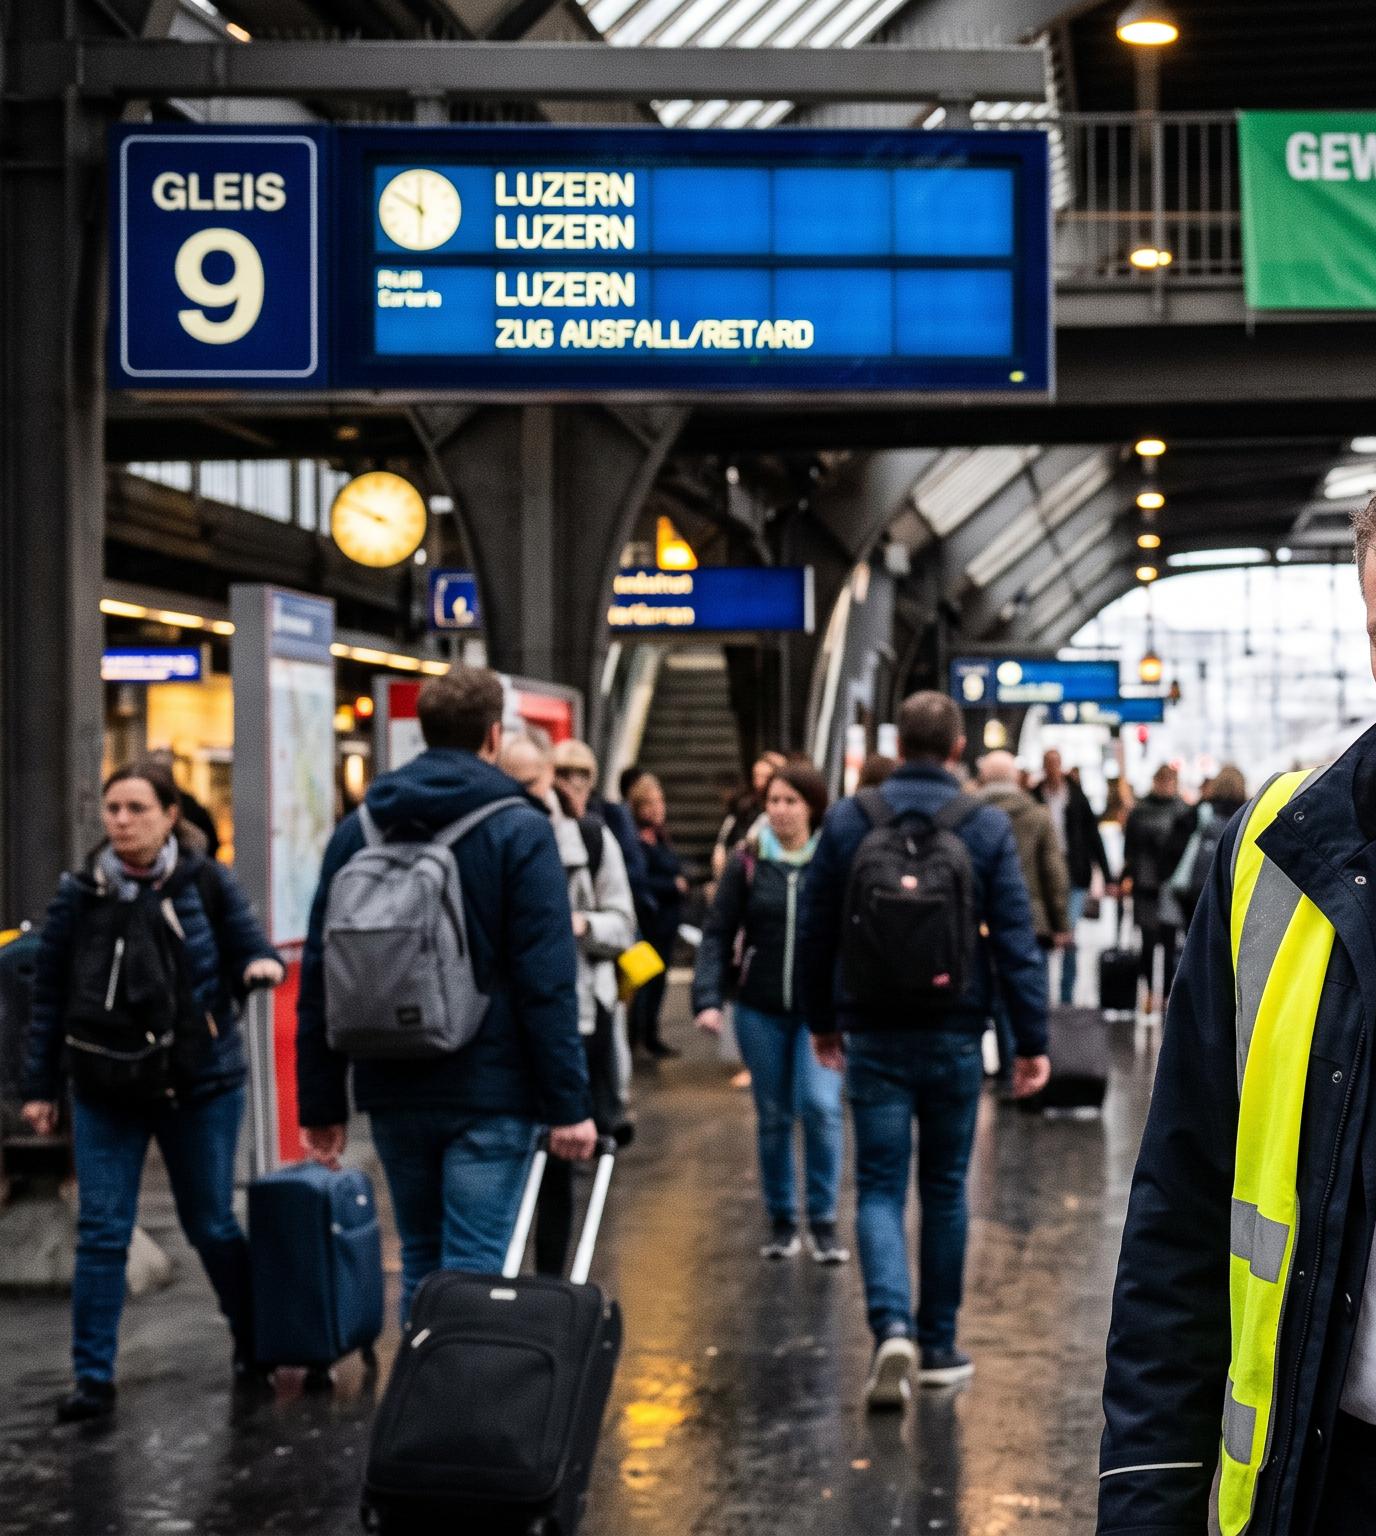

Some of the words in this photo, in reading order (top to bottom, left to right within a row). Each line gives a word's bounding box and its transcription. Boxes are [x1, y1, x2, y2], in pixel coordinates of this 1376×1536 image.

[152, 172, 286, 211] GLEIS
[496, 172, 634, 207] LUZERN
[496, 214, 634, 249] LUZERN
[175, 227, 265, 344] 9
[496, 272, 635, 307] LUZERN
[496, 319, 554, 348] ZUG
[560, 319, 813, 348] AUSFALL/RETARD
